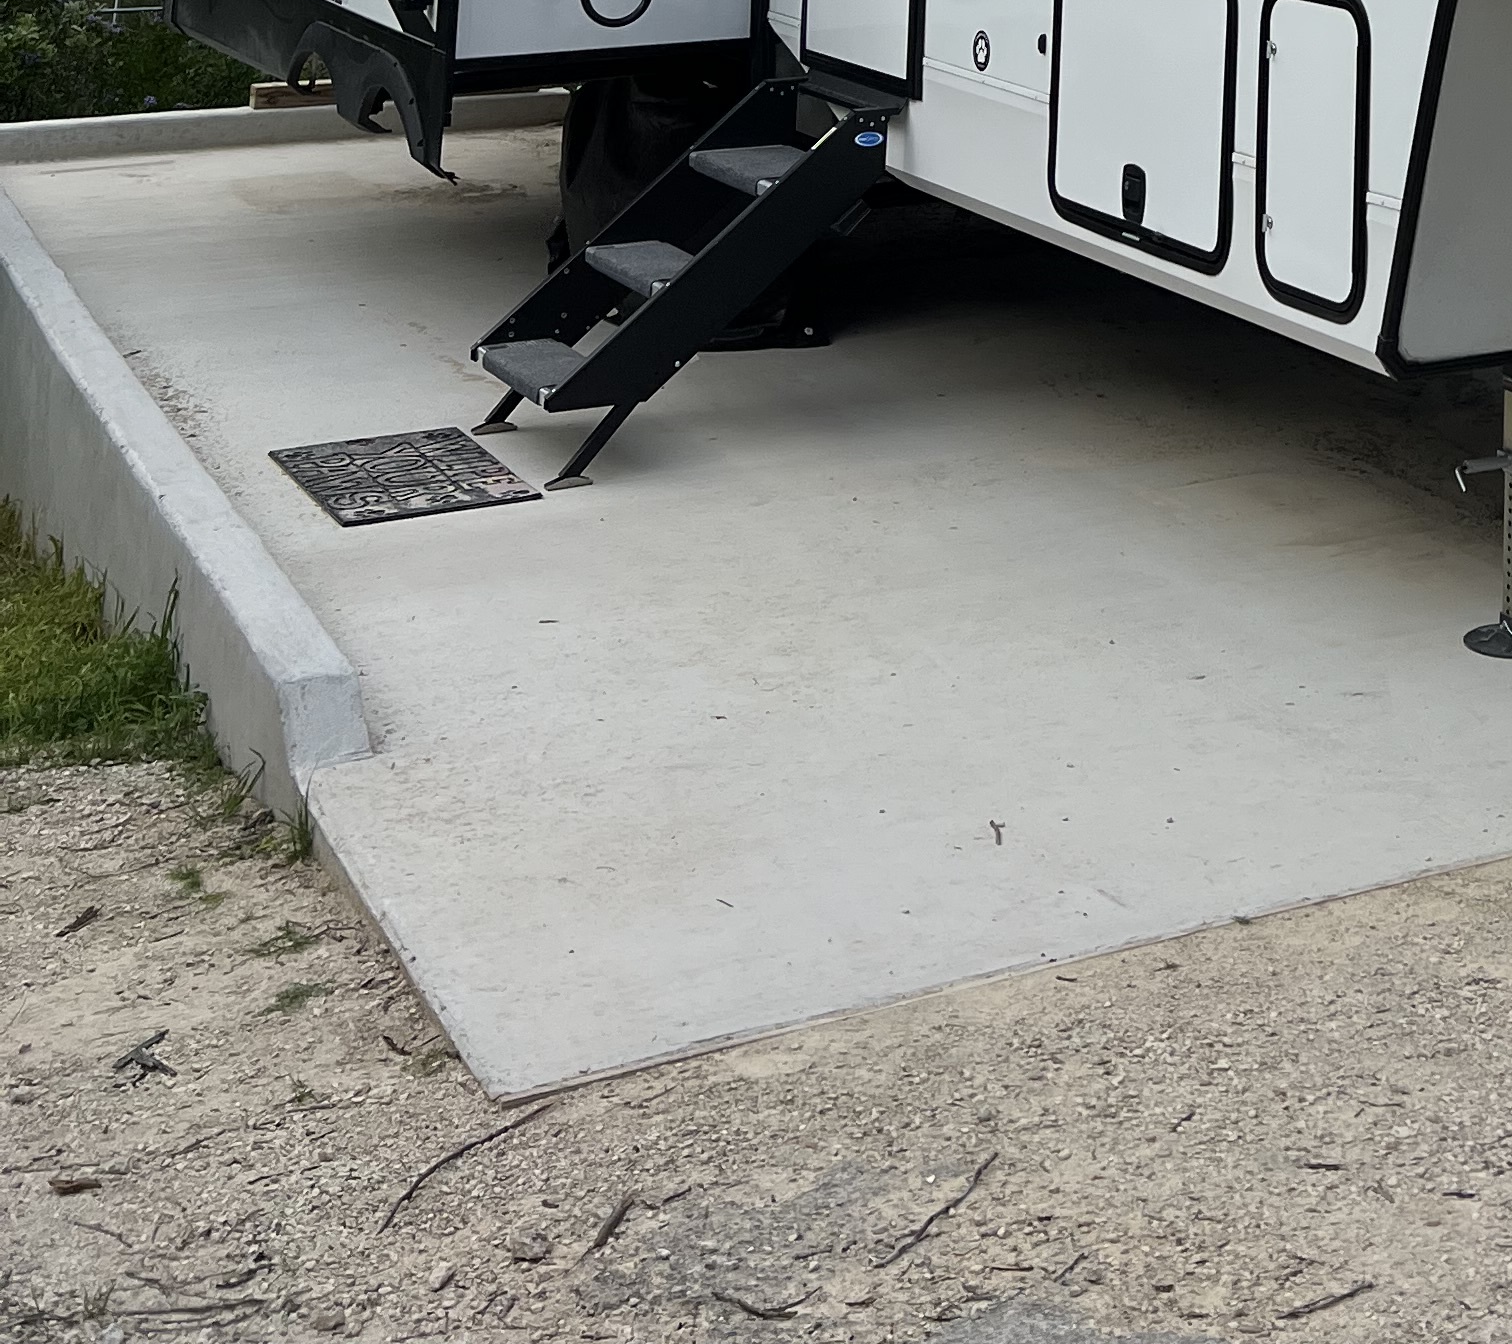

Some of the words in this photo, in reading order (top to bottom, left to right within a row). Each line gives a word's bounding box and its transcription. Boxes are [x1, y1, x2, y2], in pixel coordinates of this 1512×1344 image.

[280, 452, 385, 510] PAWS
[351, 441, 460, 502] YOUR
[417, 433, 521, 491] WIPE
